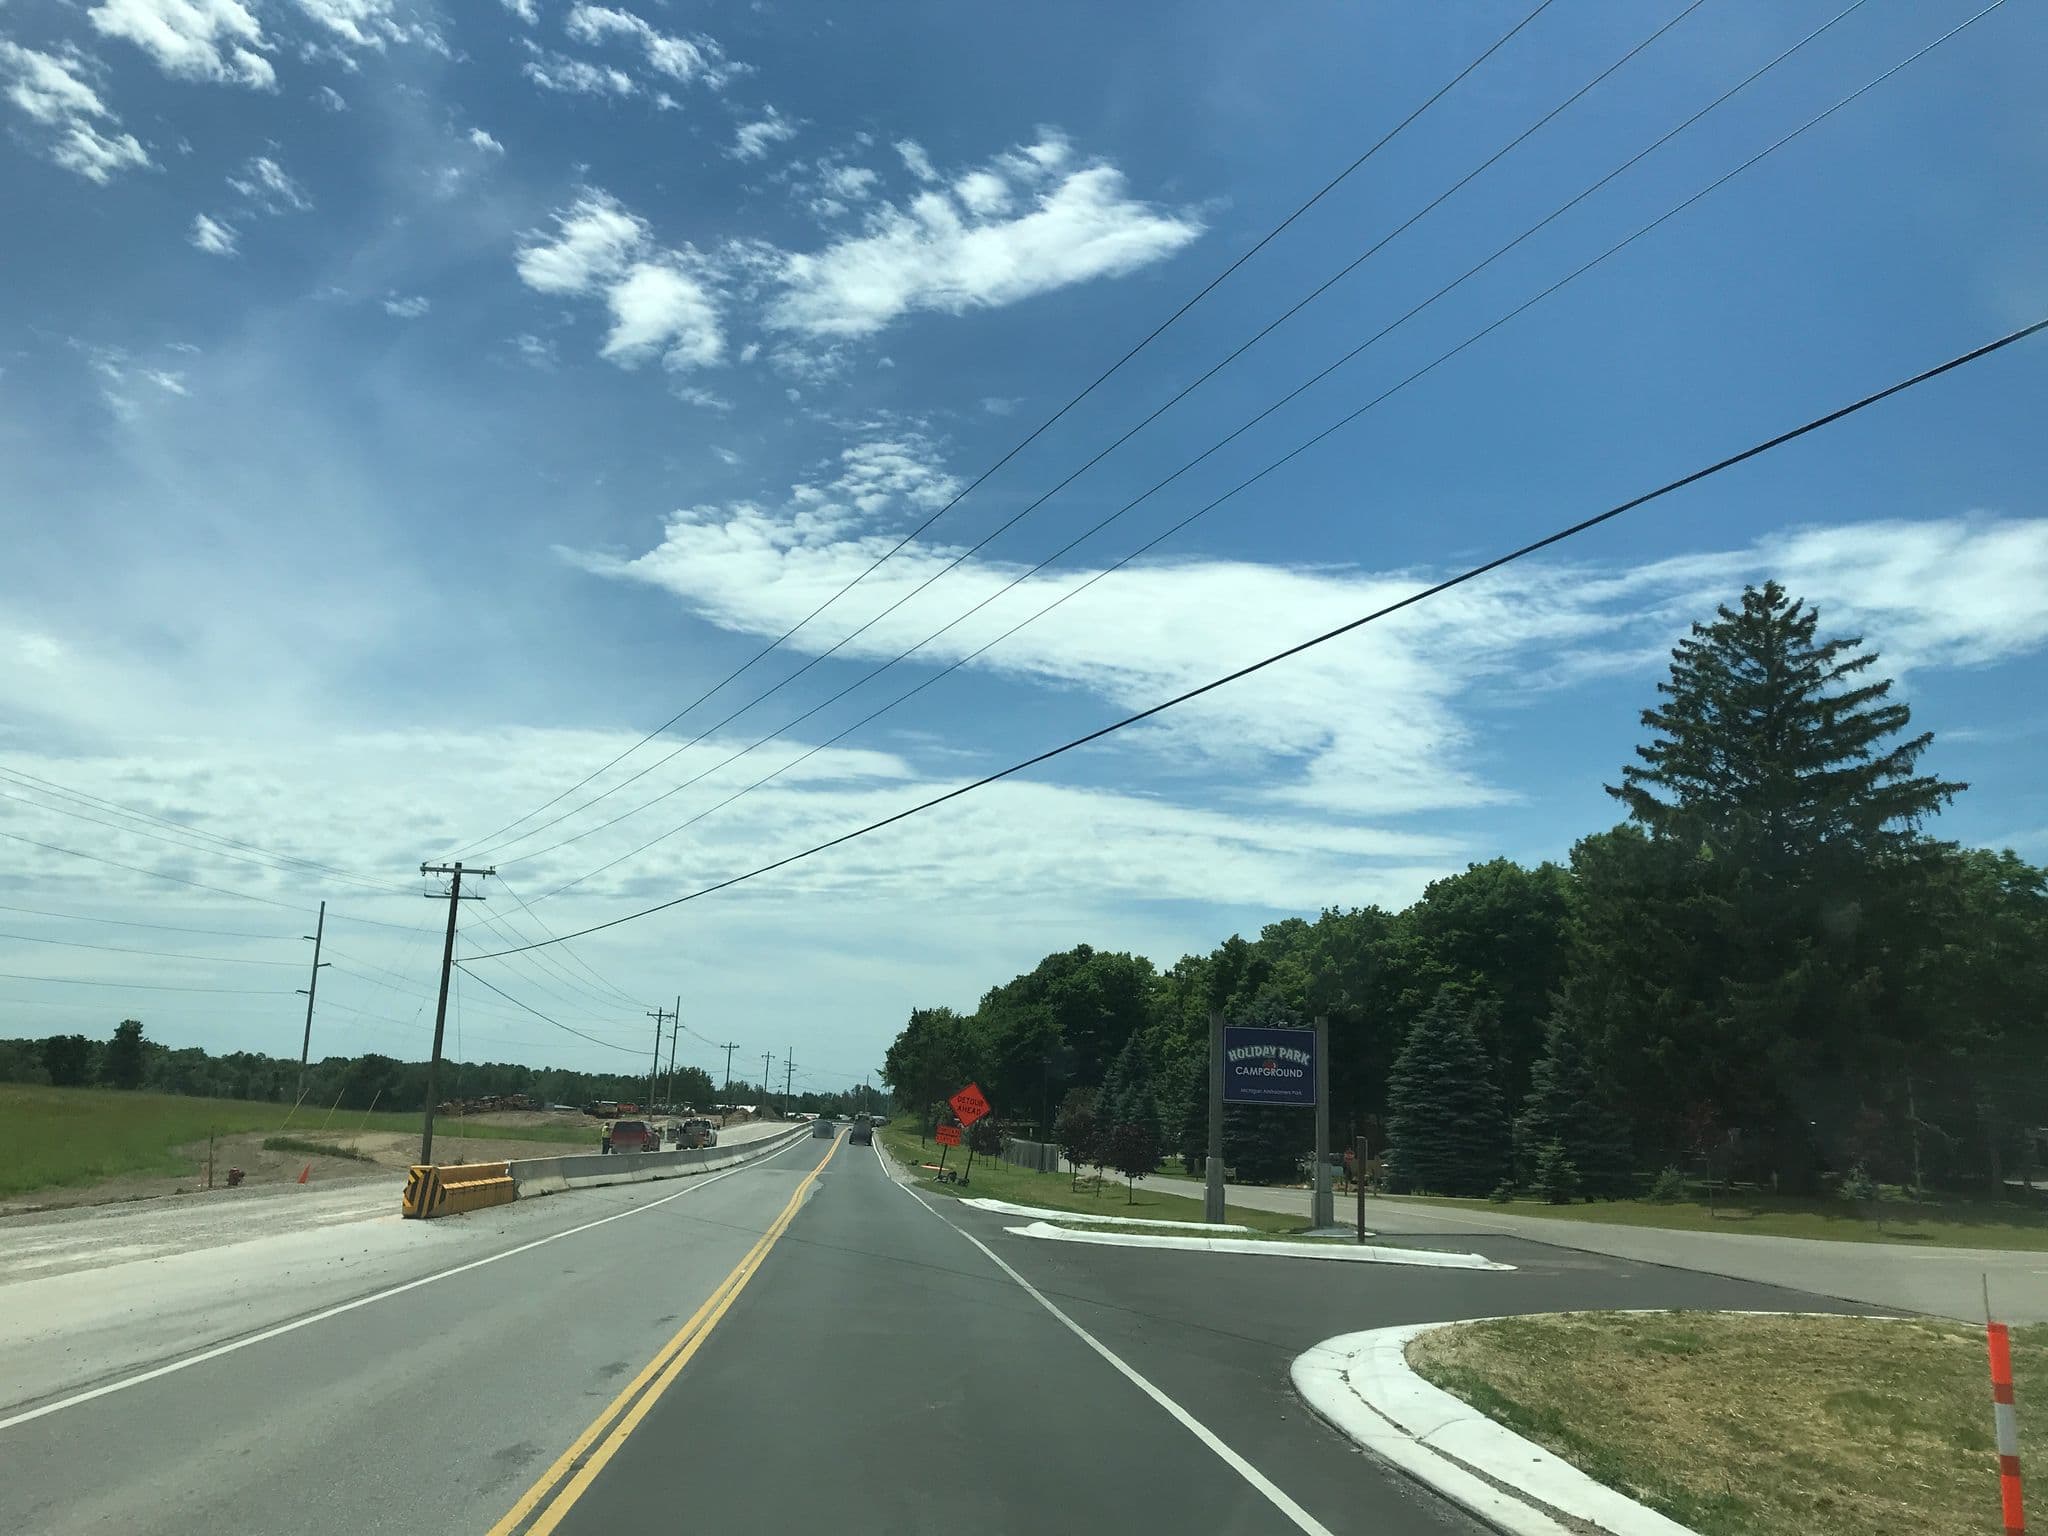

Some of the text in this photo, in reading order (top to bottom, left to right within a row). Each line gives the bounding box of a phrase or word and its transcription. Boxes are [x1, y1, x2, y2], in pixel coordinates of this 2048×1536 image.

[1228, 1045, 1310, 1066] HOLIDAY PARK
[1235, 1066, 1303, 1078] CAMPGROUND
[957, 1096, 984, 1107] DETOUR
[957, 1106, 981, 1116] AHEAD
